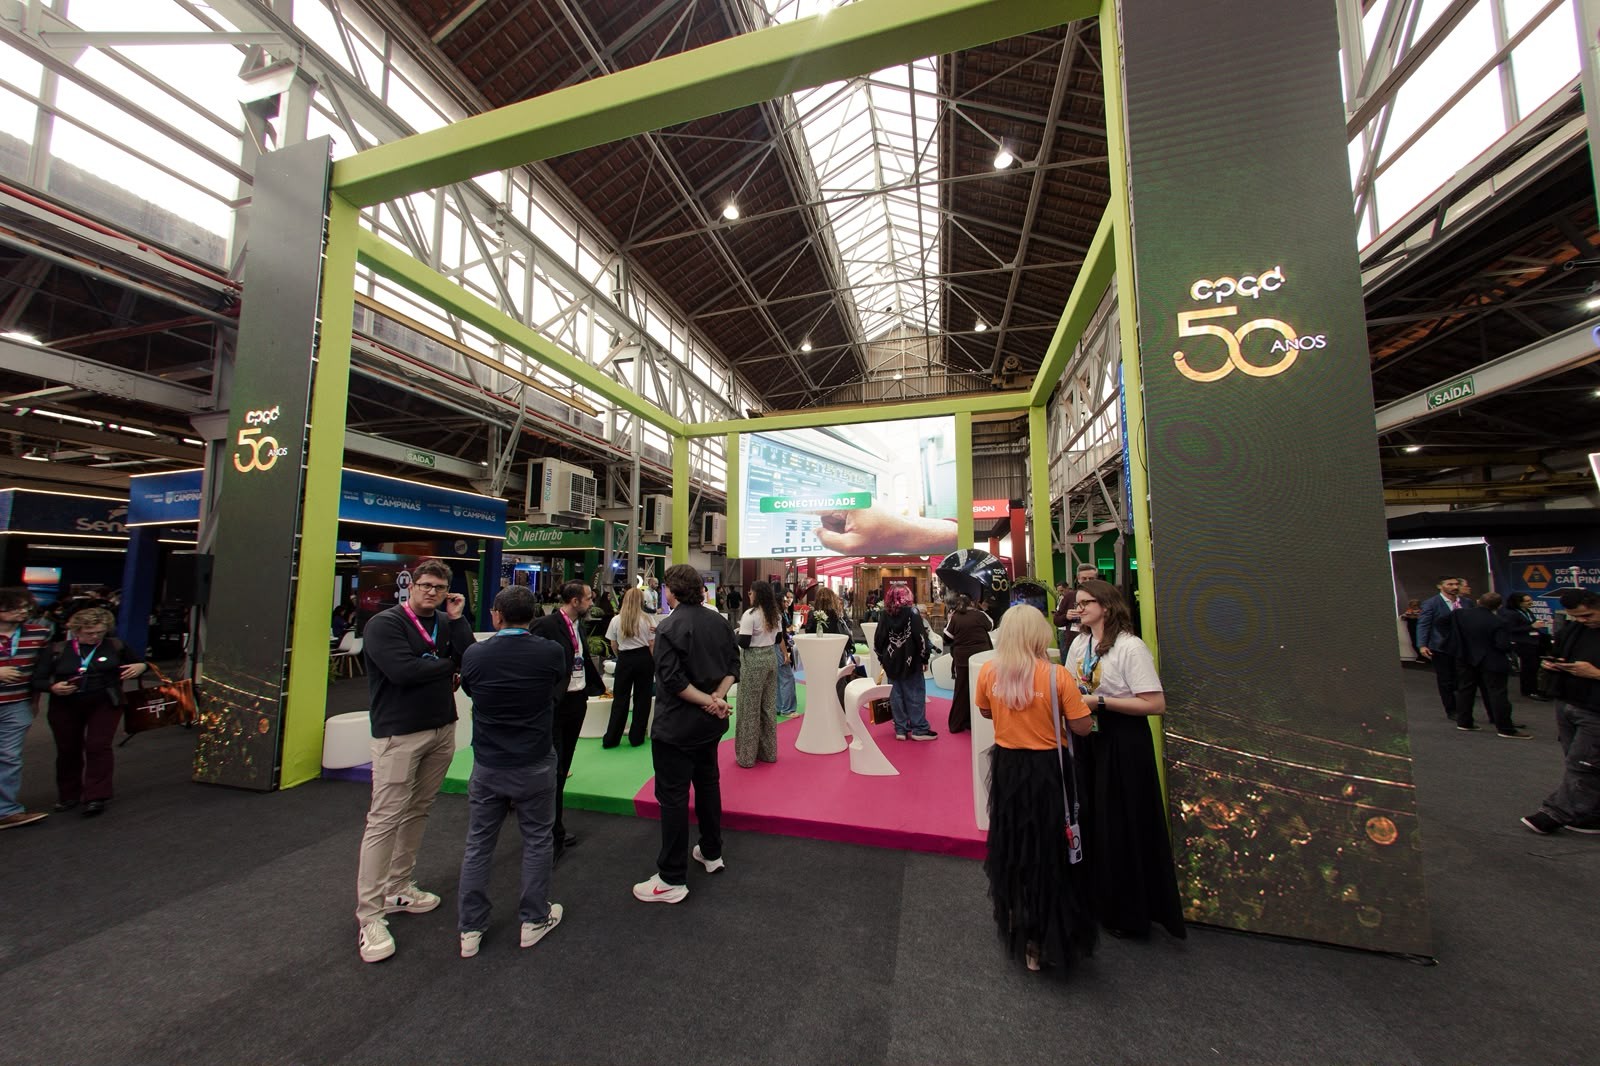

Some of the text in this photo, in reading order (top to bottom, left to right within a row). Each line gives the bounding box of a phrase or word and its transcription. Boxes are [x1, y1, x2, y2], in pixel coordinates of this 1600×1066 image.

[1172, 305, 1328, 382] 50 ANOS
[1434, 383, 1473, 405] SAÍDA
[233, 427, 288, 473] 50 ANOS
[376, 498, 421, 511] CAMPINAS
[773, 497, 856, 509] CONECTIVIDADE
[462, 510, 496, 522] CAMPINAS
[522, 530, 563, 542] NetTurbo
[991, 575, 1009, 591] 50
